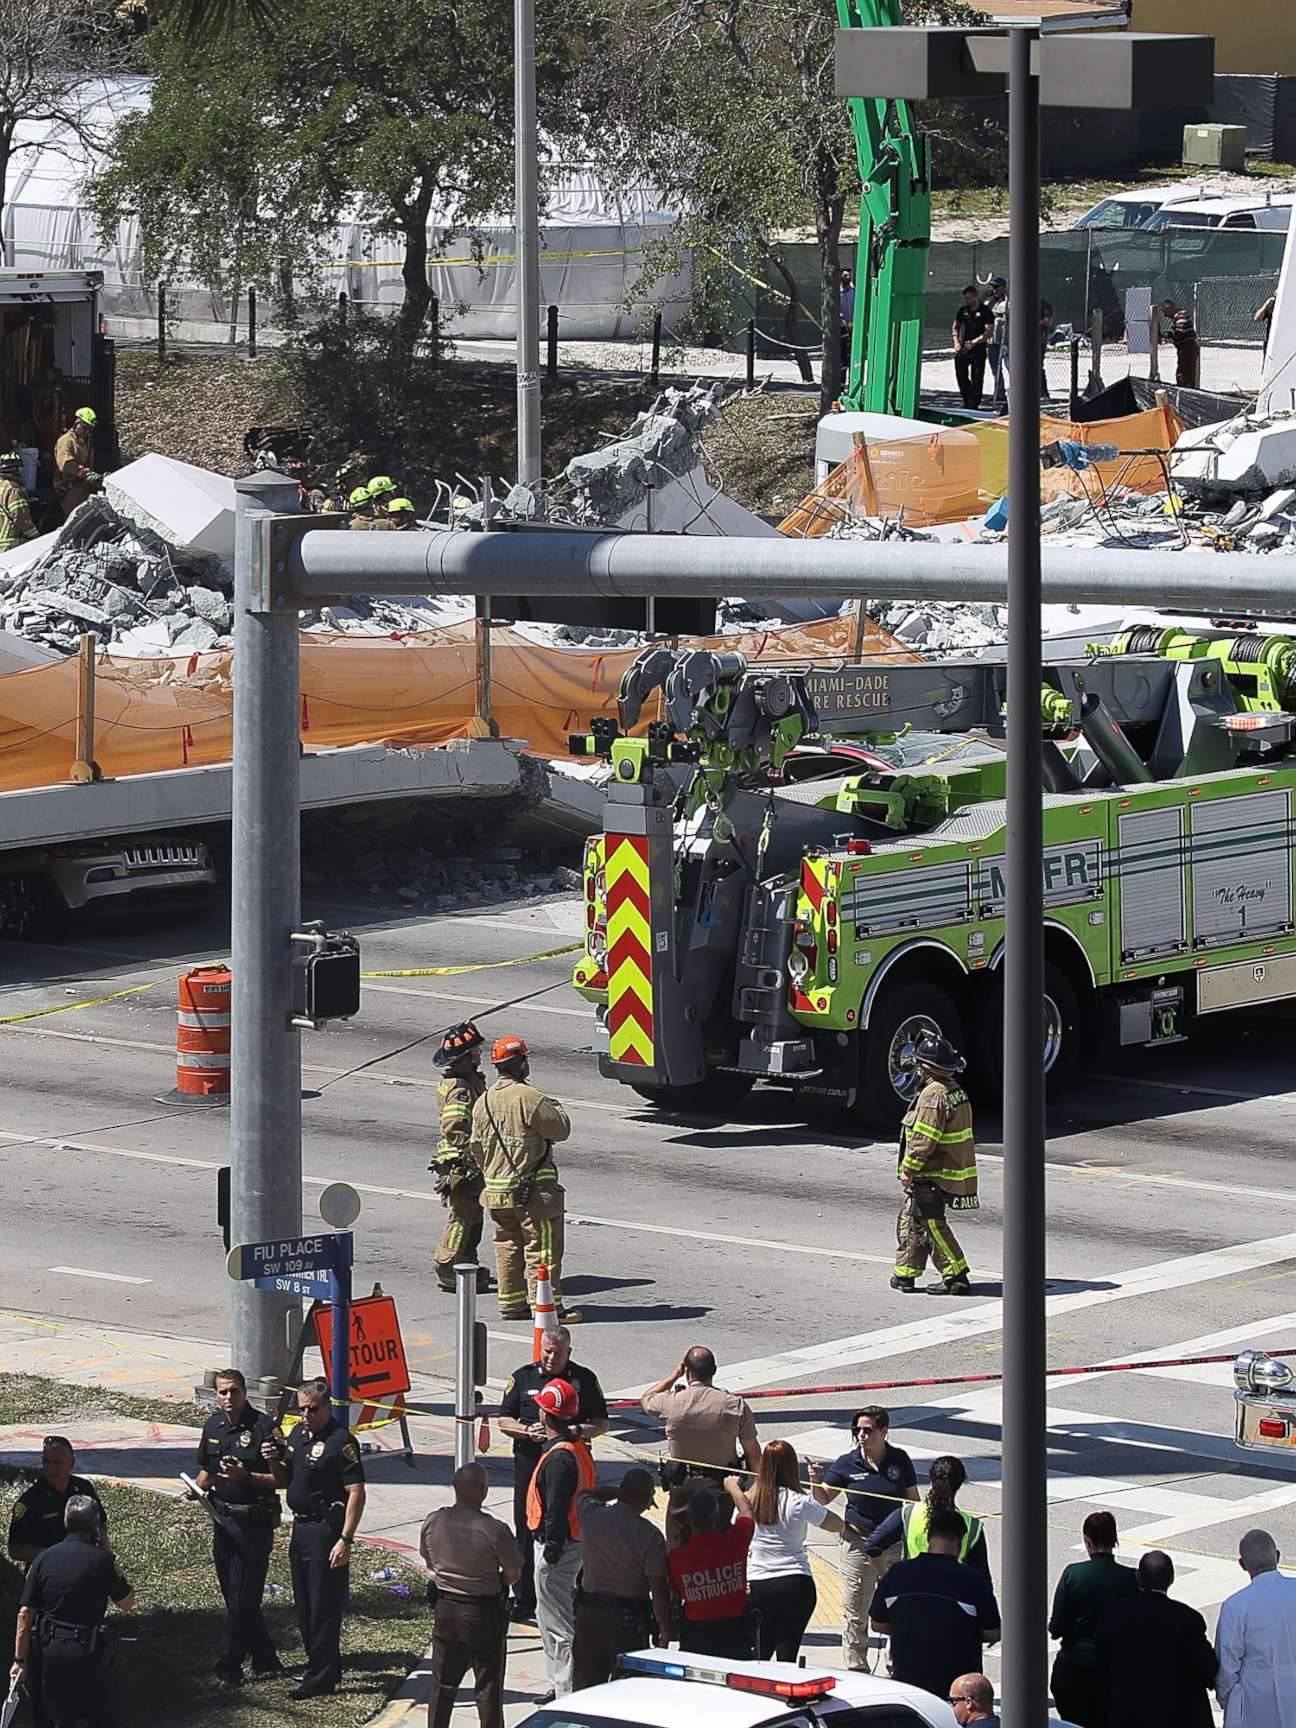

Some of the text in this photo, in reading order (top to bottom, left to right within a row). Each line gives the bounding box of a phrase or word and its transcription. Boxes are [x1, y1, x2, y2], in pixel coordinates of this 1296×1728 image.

[813, 692, 889, 709] RE RESCUE
[990, 853, 1089, 899] MFR
[1238, 905, 1246, 927] 1
[254, 1239, 322, 1261] FIU PLACE
[264, 1263, 281, 1275] SW
[285, 1259, 302, 1272] 109
[276, 1279, 311, 1295] SW 8 ST
[329, 1340, 399, 1368] TOUR
[681, 1562, 743, 1588] POLICE
[685, 1576, 743, 1602] INSTRUCTOR
